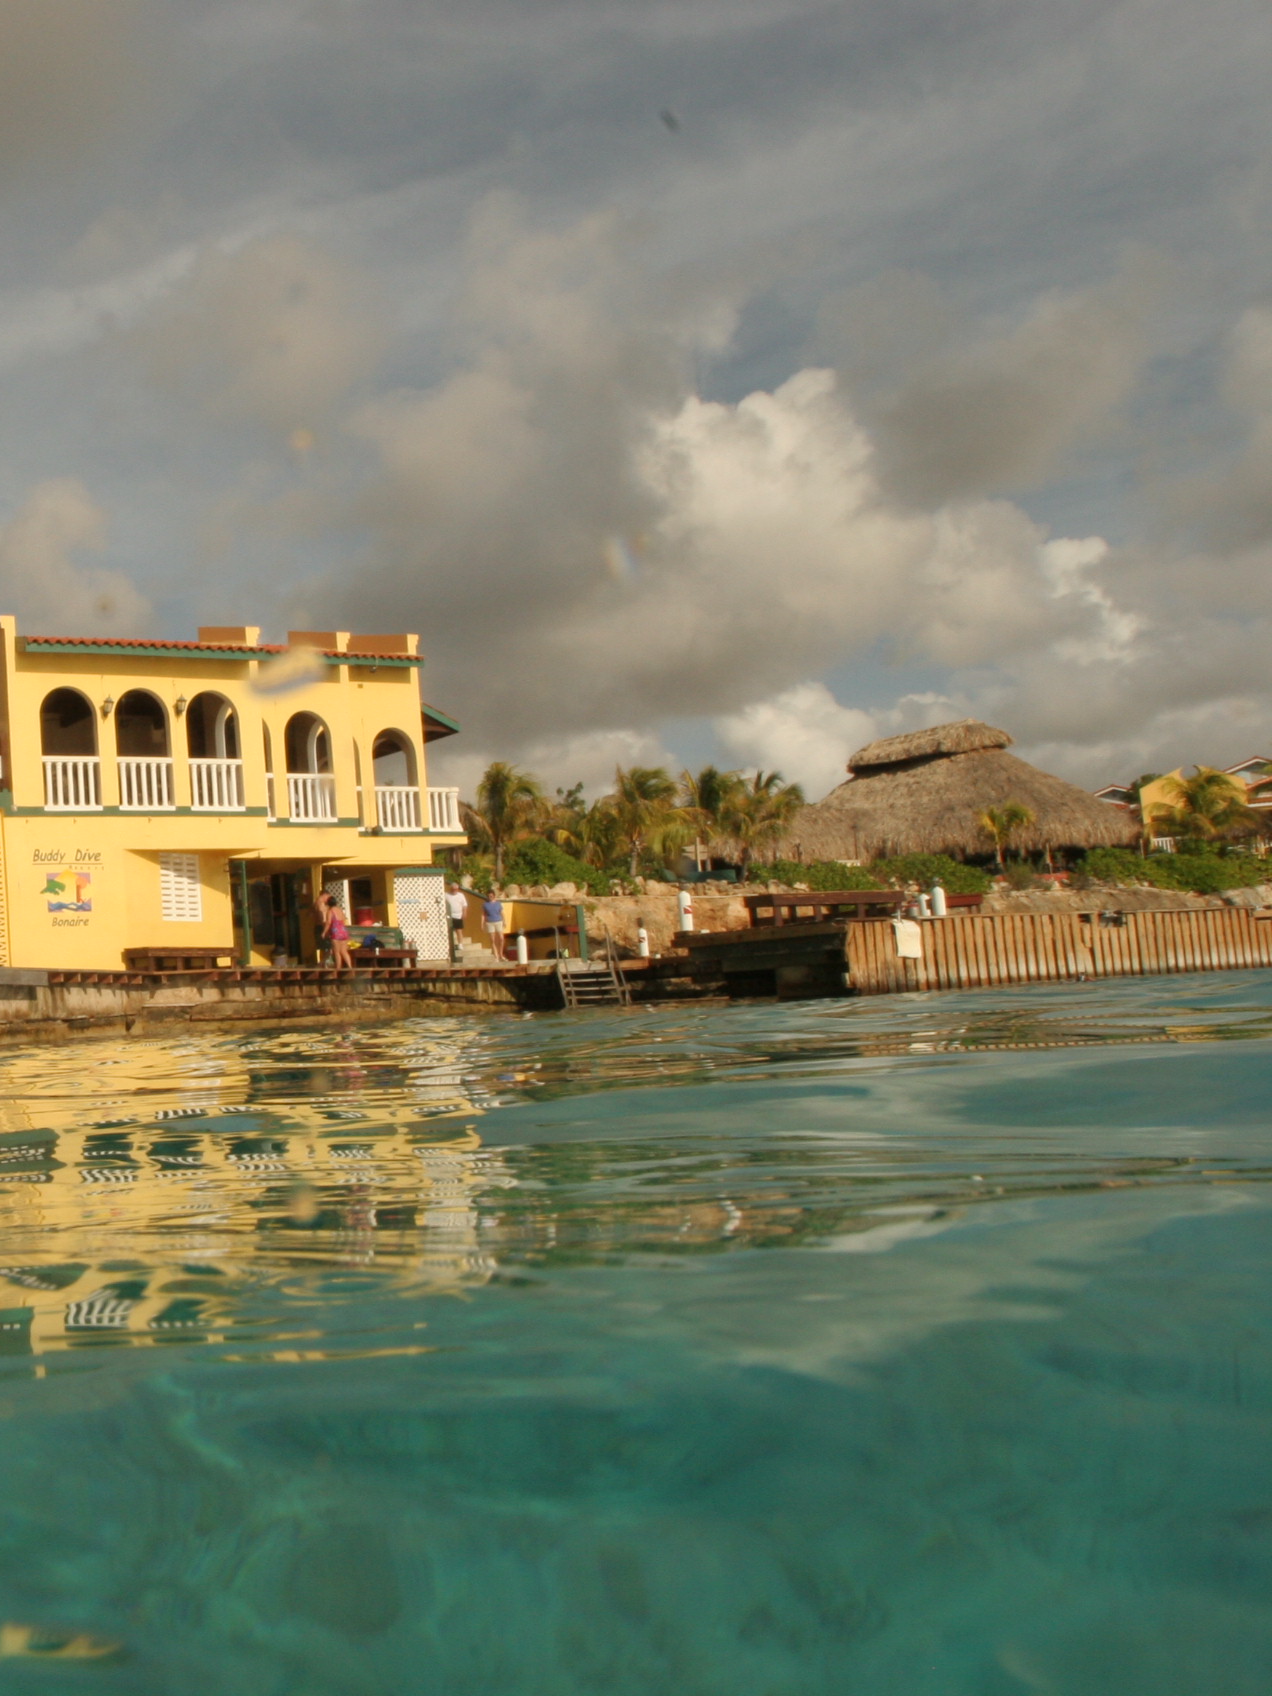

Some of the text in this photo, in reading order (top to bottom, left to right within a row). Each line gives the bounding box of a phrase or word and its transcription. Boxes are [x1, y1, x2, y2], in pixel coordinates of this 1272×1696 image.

[33, 849, 102, 864] Buddy Dive
[51, 916, 90, 927] Bonaire
